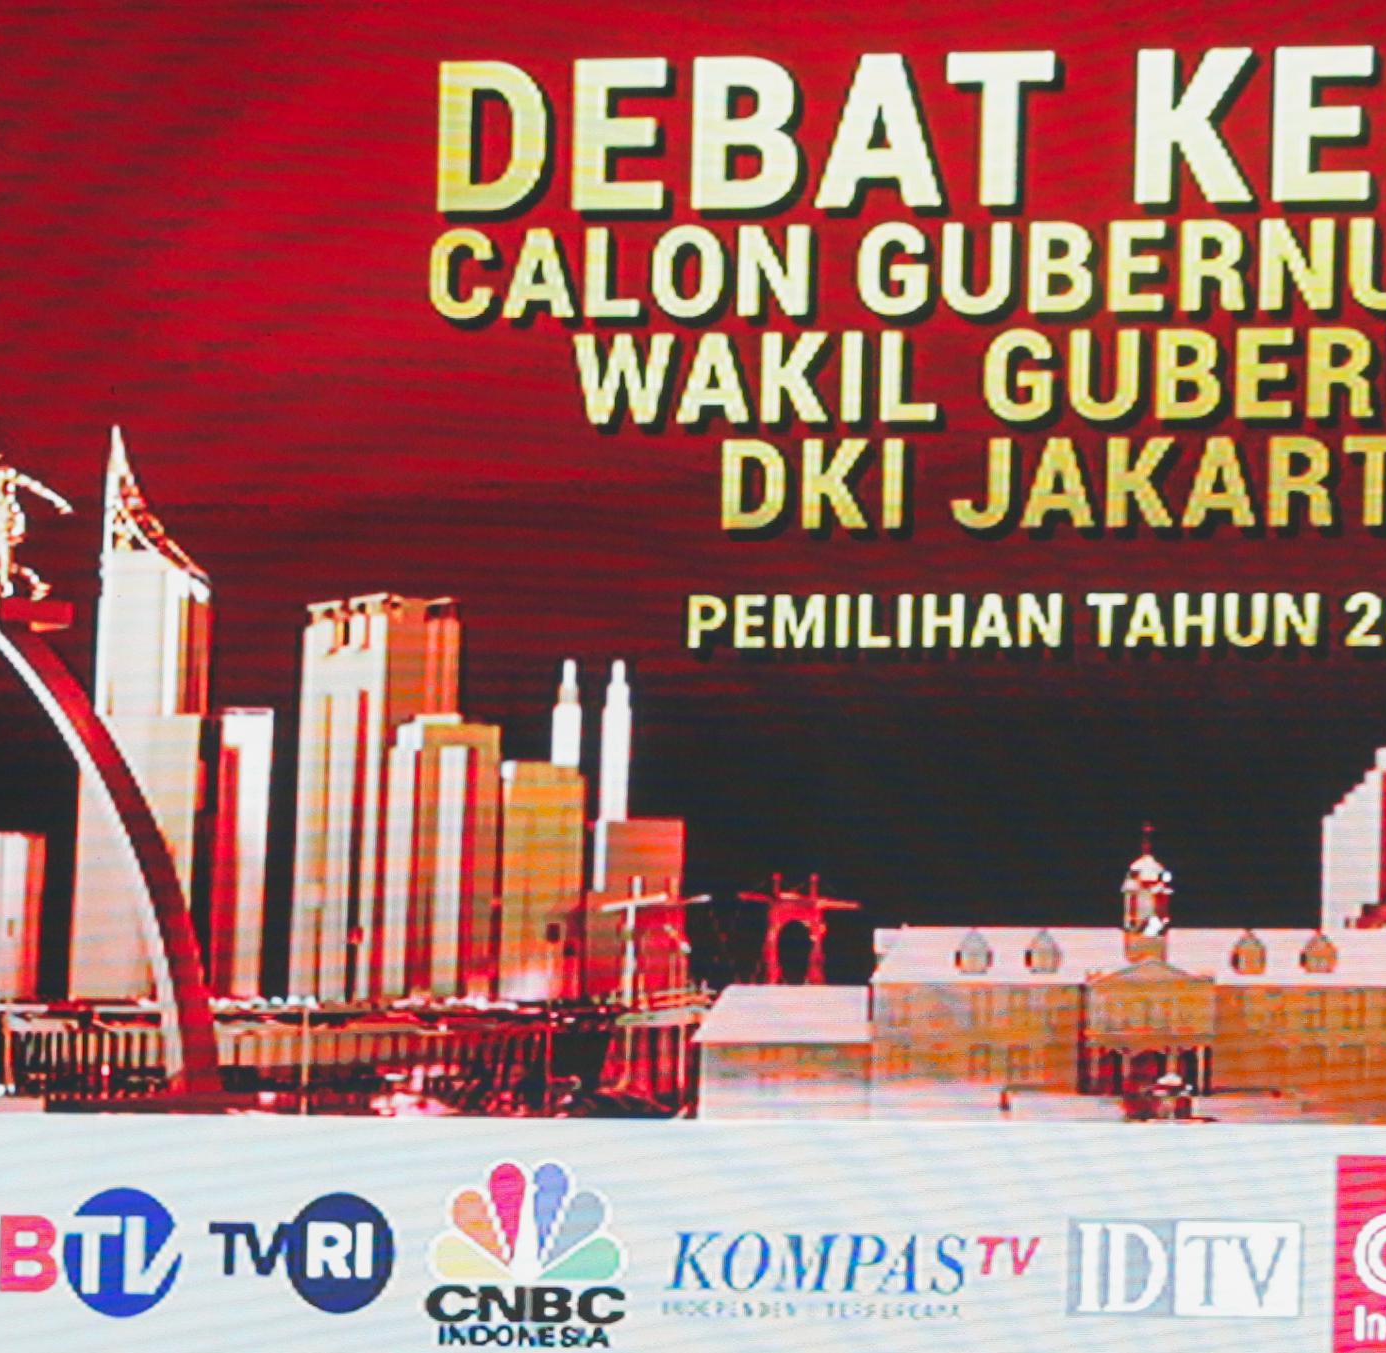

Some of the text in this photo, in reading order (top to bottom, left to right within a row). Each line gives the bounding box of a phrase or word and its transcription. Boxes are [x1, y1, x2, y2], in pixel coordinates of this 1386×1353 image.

[435, 50, 1059, 212] DEBAT
[428, 224, 813, 320] CALON
[573, 330, 938, 425] WAKIL
[720, 436, 905, 530] DKI
[686, 594, 1065, 649] PEMILIHAN
[1085, 592, 1320, 646] TAHUN
[0, 1212, 181, 1296] BTV
[207, 1219, 374, 1281] TVRI
[664, 1230, 967, 1296] KOMPAS
[424, 1284, 627, 1324] CNBC
[437, 1325, 611, 1349] INDONESIA
